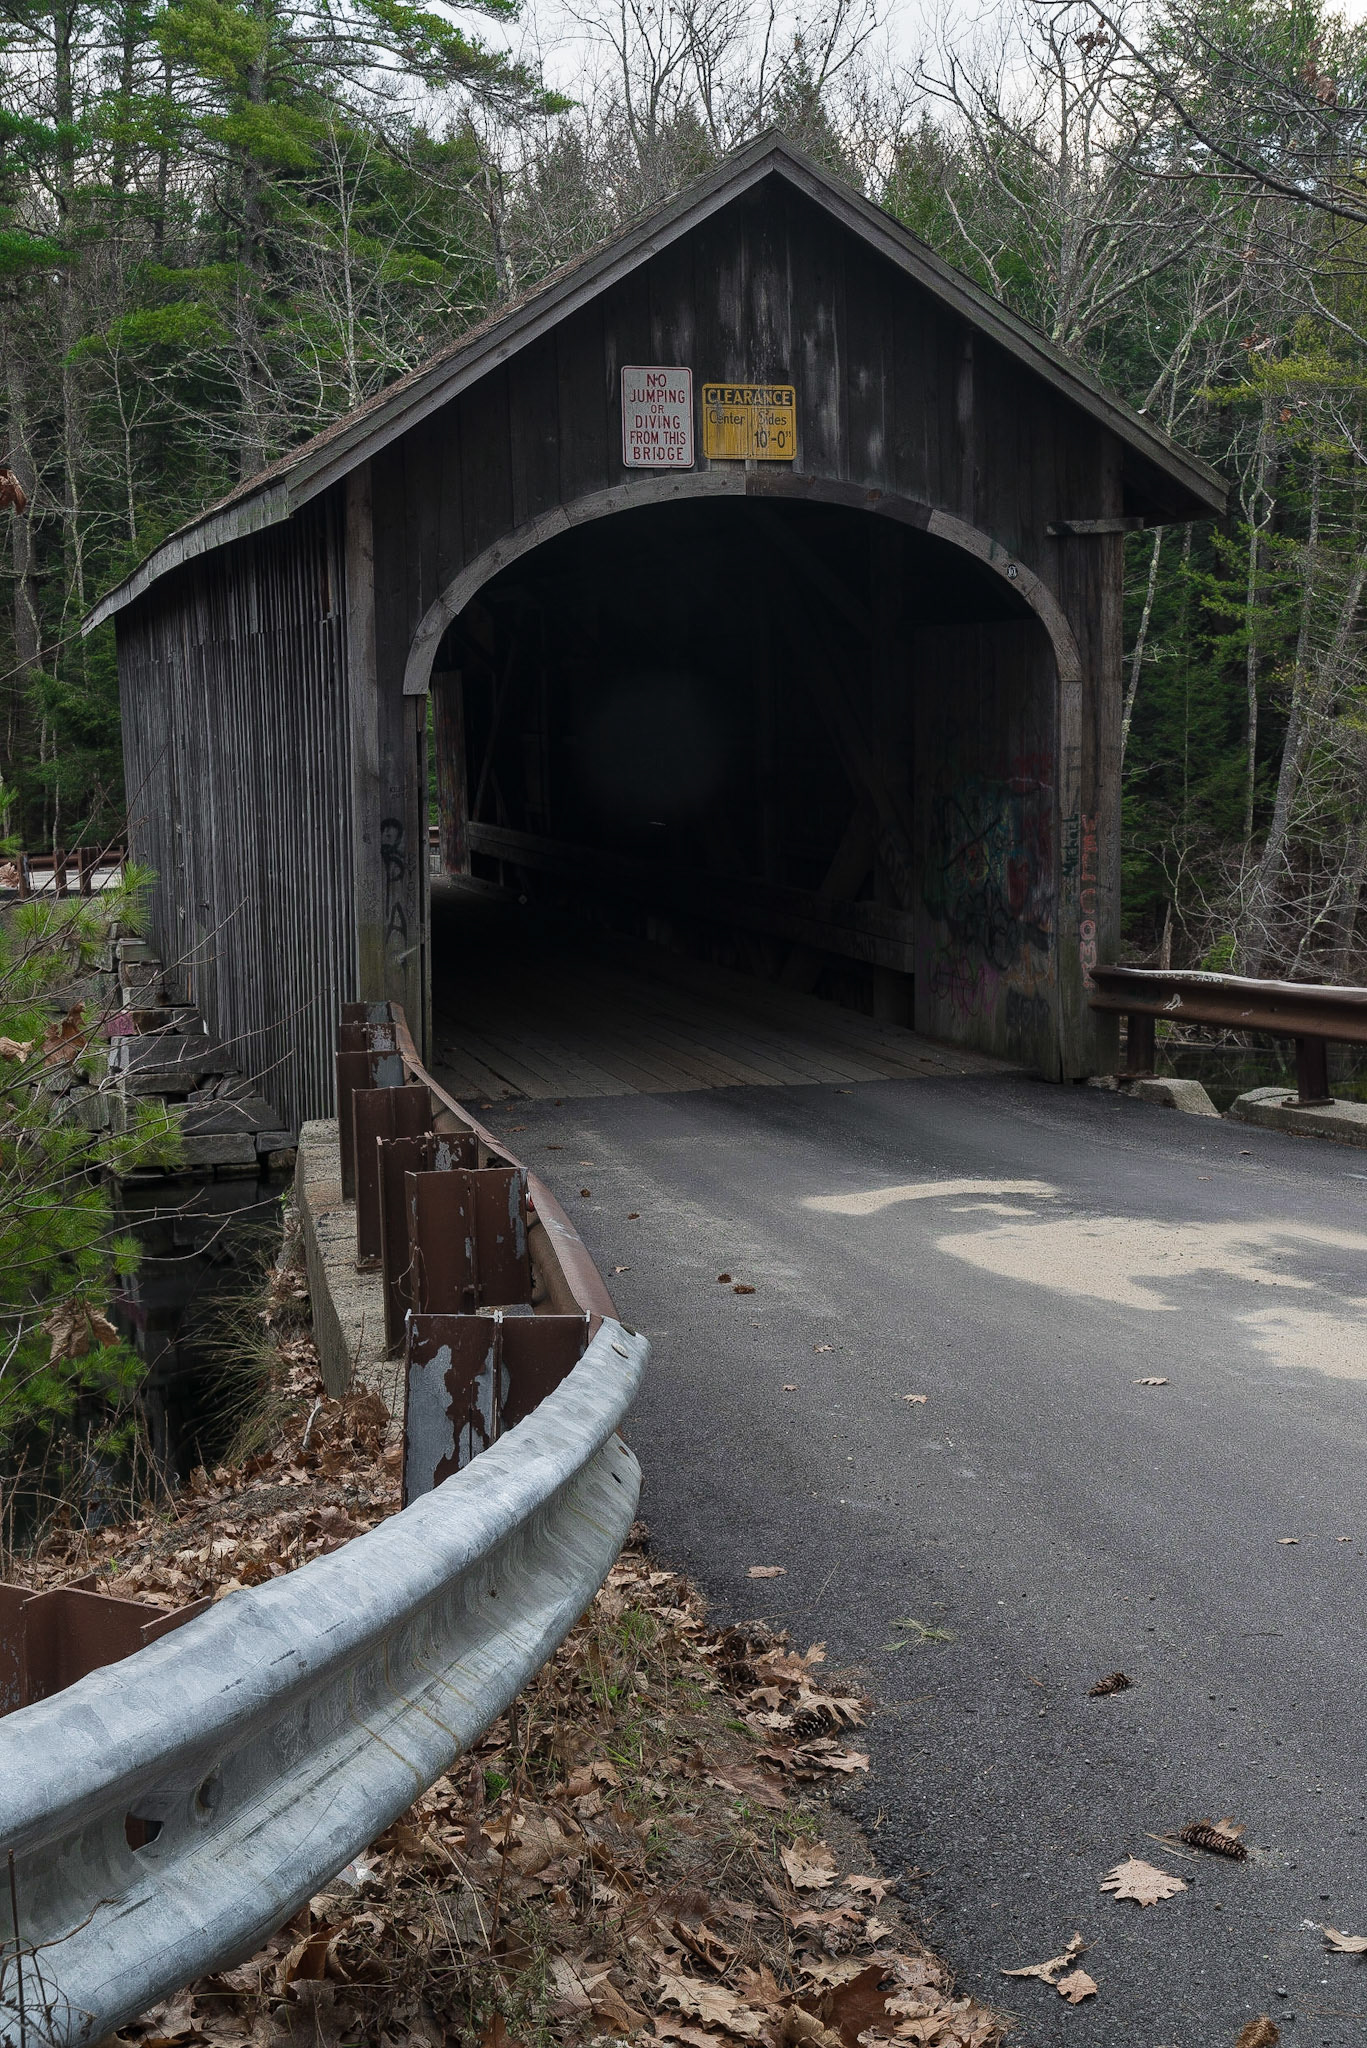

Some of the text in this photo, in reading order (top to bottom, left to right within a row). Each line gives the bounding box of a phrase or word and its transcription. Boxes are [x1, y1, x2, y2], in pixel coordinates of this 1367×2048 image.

[647, 373, 667, 387] NO
[630, 389, 685, 403] JUMPING
[708, 389, 791, 405] CLEARANCE
[651, 404, 664, 414] OR
[635, 415, 680, 429] DIVING
[709, 410, 787, 425] Center Sides
[630, 431, 686, 445] FROM THIS
[633, 447, 684, 460] BRIDGE
